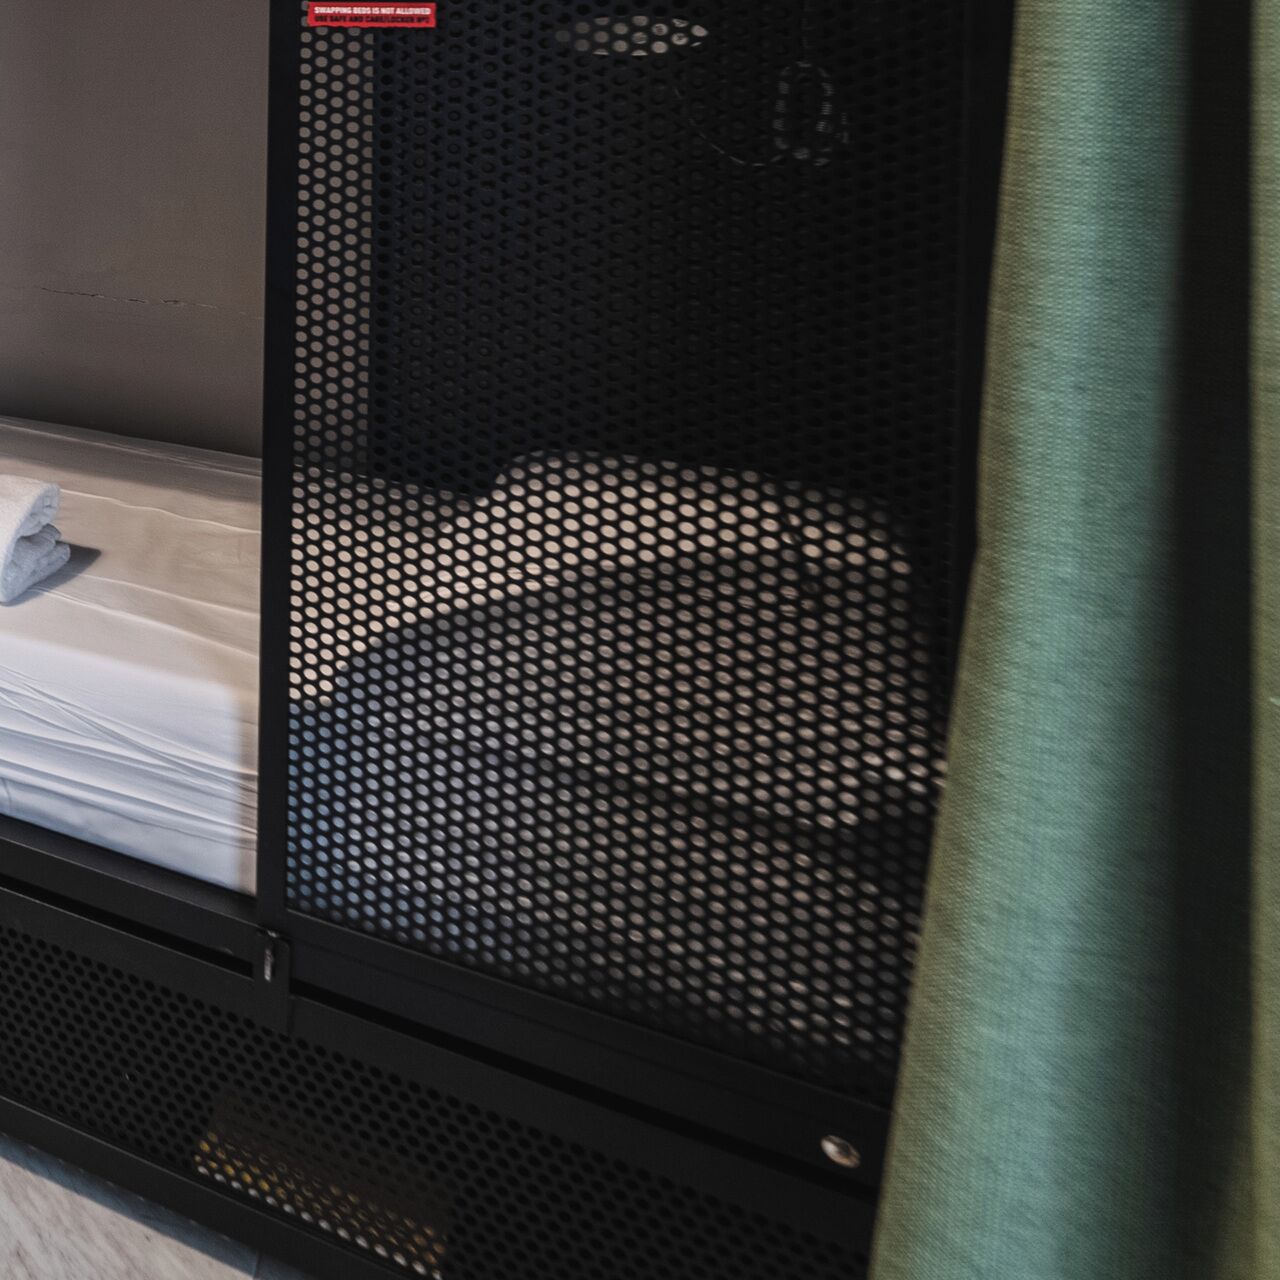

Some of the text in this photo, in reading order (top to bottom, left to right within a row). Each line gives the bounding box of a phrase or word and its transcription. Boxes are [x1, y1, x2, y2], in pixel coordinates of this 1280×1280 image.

[313, 6, 431, 16] SWAPPING BEDS IS NOT ALLOWED
